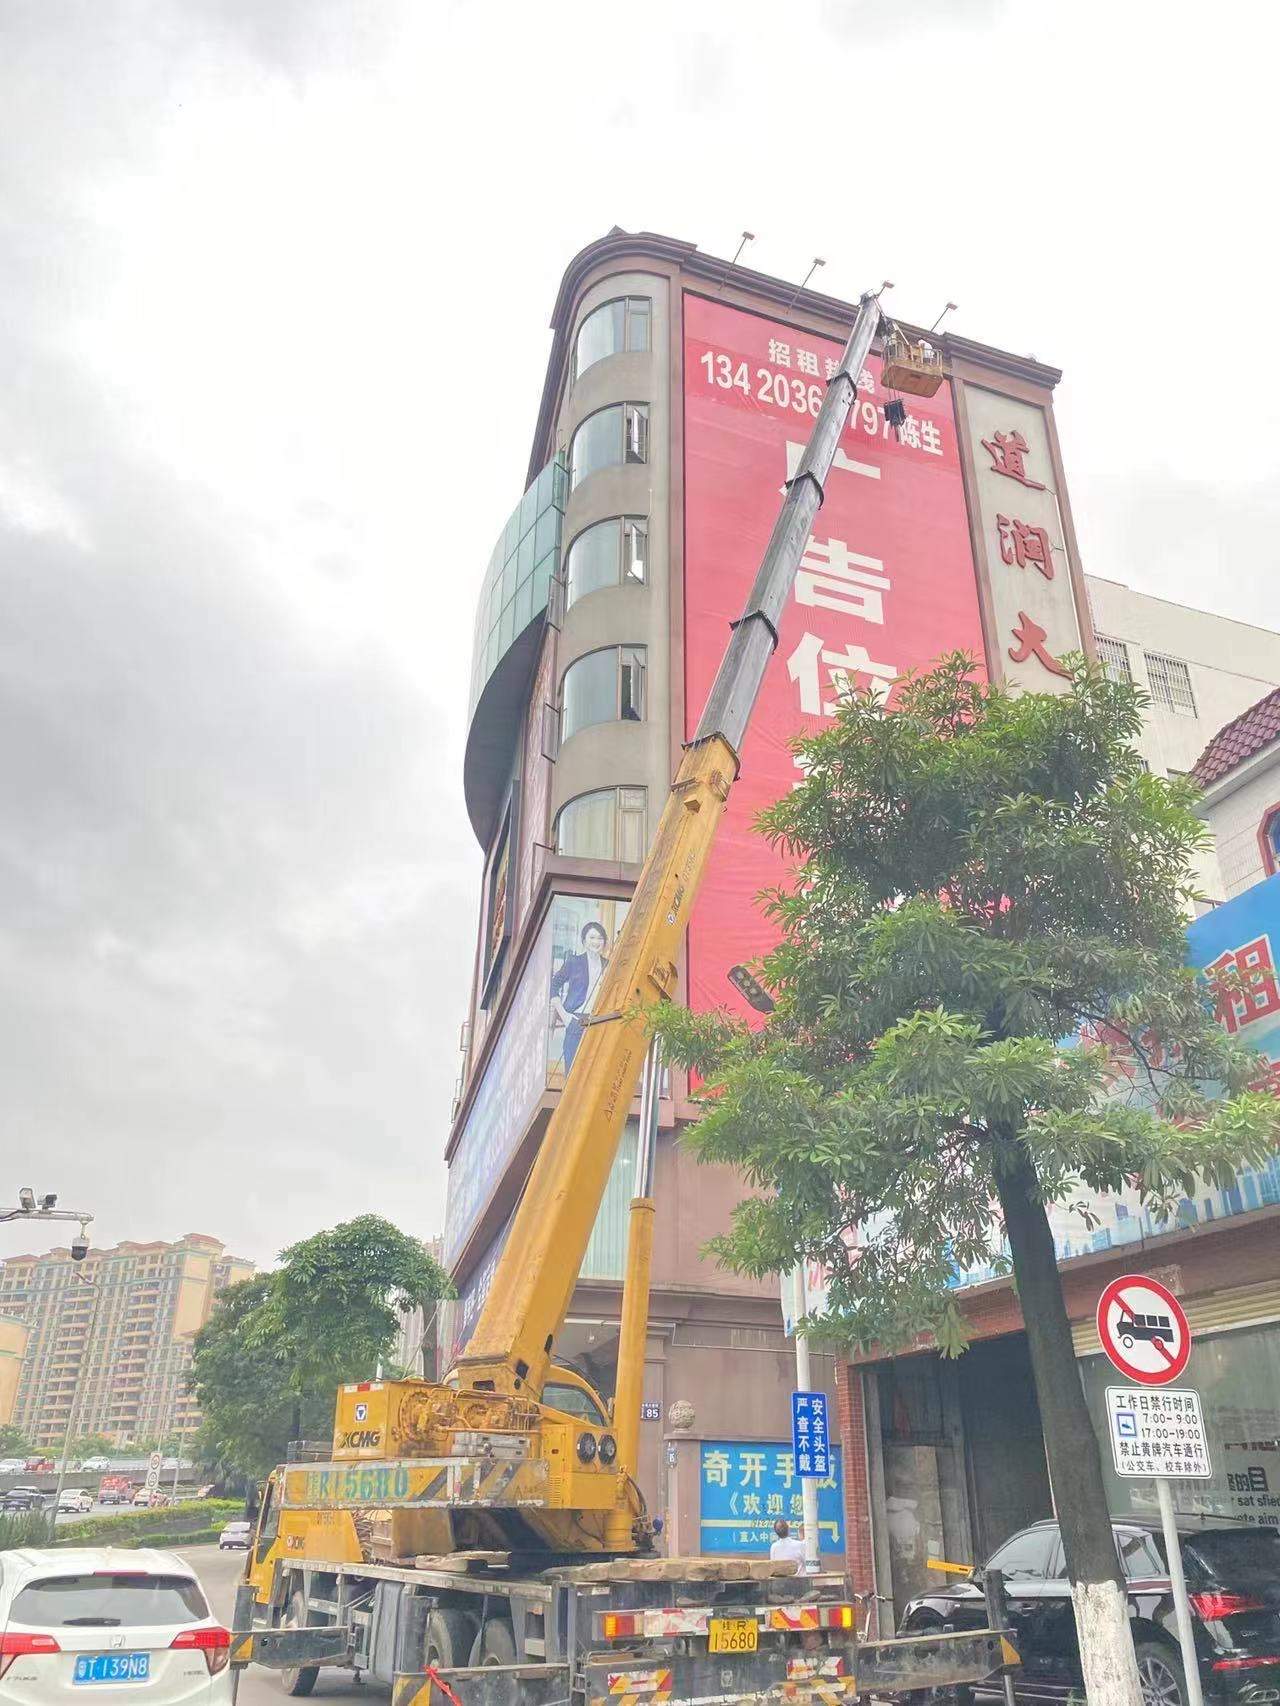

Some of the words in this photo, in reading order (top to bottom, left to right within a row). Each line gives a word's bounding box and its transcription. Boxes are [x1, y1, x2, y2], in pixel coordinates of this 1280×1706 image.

[700, 351, 751, 396] 134
[1116, 1395, 1195, 1412] 工作日禁行时间
[646, 1408, 659, 1418] 85
[338, 1430, 381, 1448] XCMG
[796, 1397, 811, 1472] 严查不戴
[811, 1398, 827, 1472] 安全头盔
[1141, 1428, 1201, 1439] 17:00-19:00
[1119, 1441, 1203, 1458] 禁止黄牌汽车通行
[714, 1632, 756, 1651] 15680
